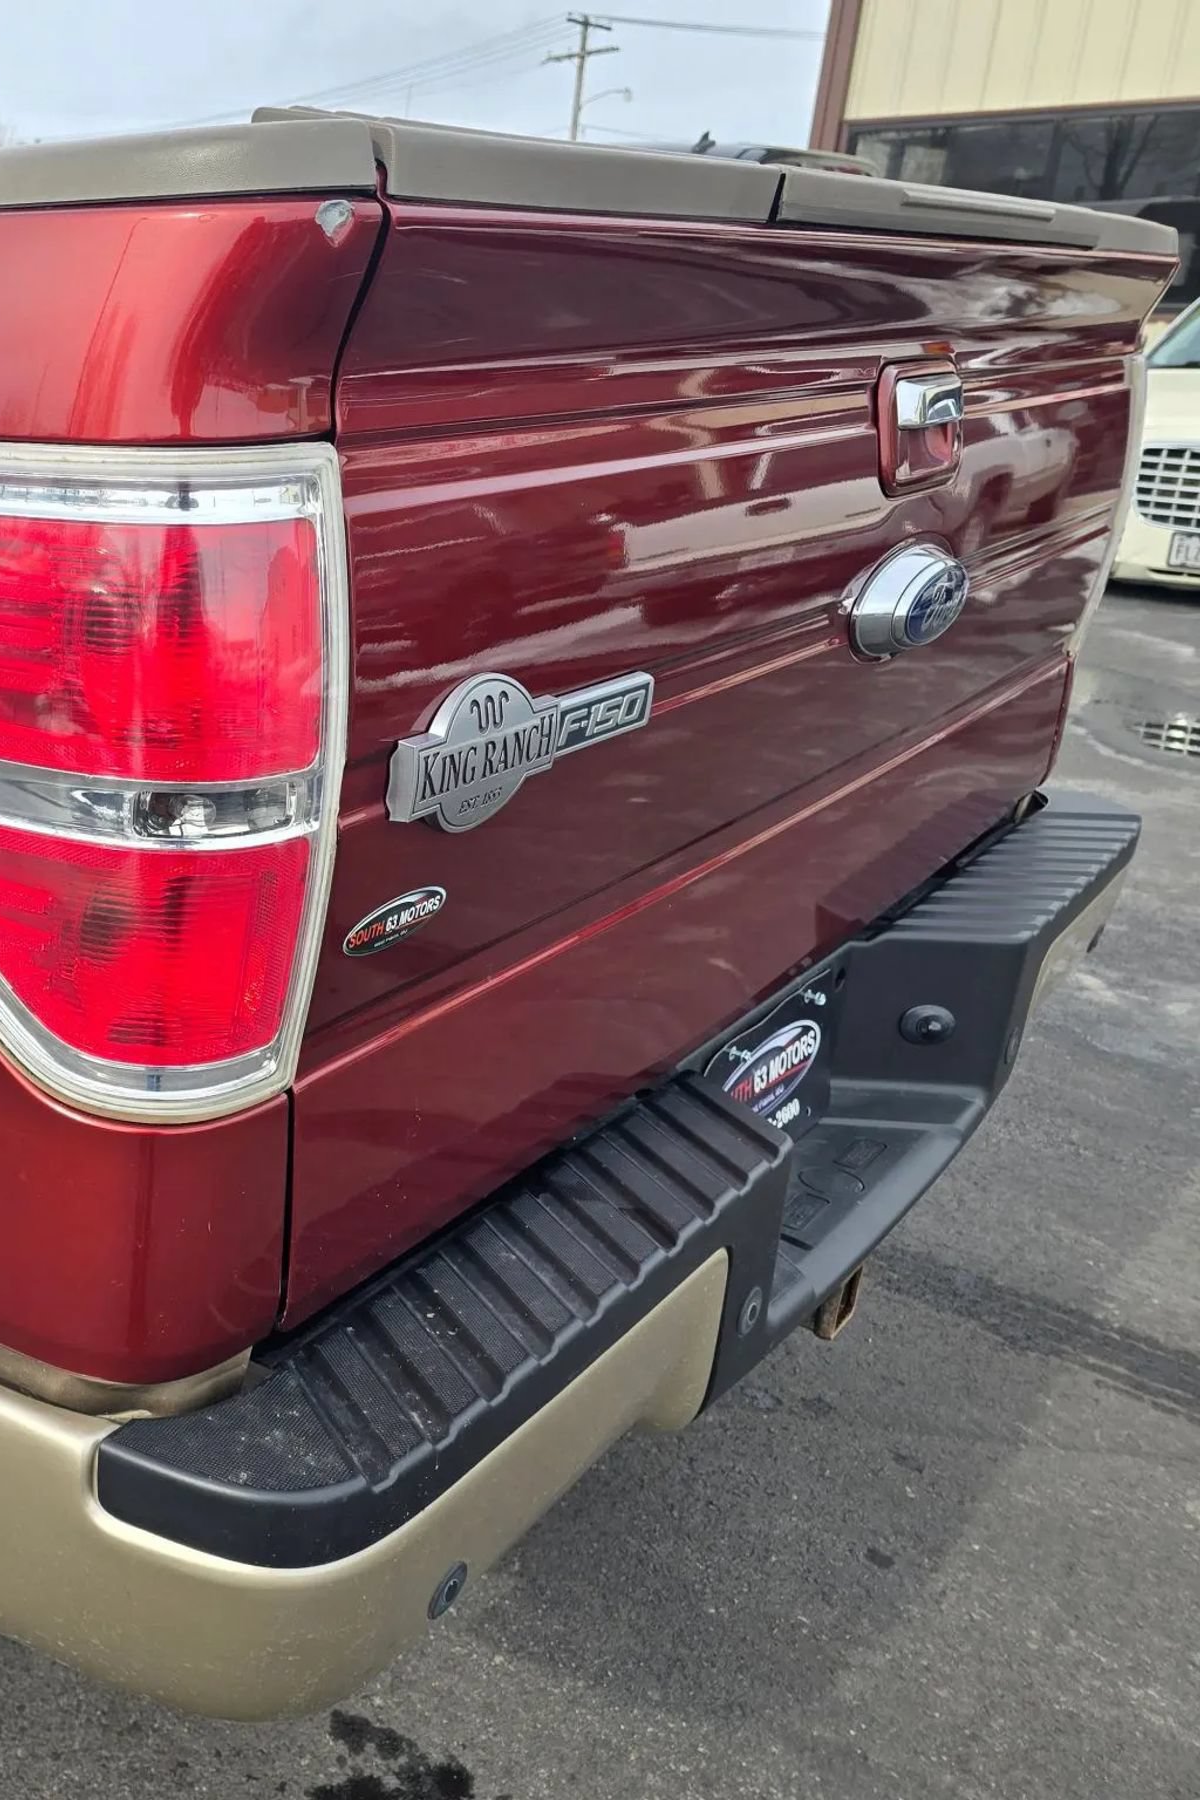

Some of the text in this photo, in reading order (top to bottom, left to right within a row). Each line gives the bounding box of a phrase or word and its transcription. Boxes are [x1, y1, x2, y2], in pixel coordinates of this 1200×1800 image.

[558, 689, 647, 747] F-150
[419, 713, 554, 801] KING RANCH
[348, 920, 385, 948] SOUTH
[385, 914, 399, 931] 63
[399, 895, 441, 926] MOTORS
[753, 1065, 768, 1093] 63
[768, 1029, 816, 1084] MOTORS
